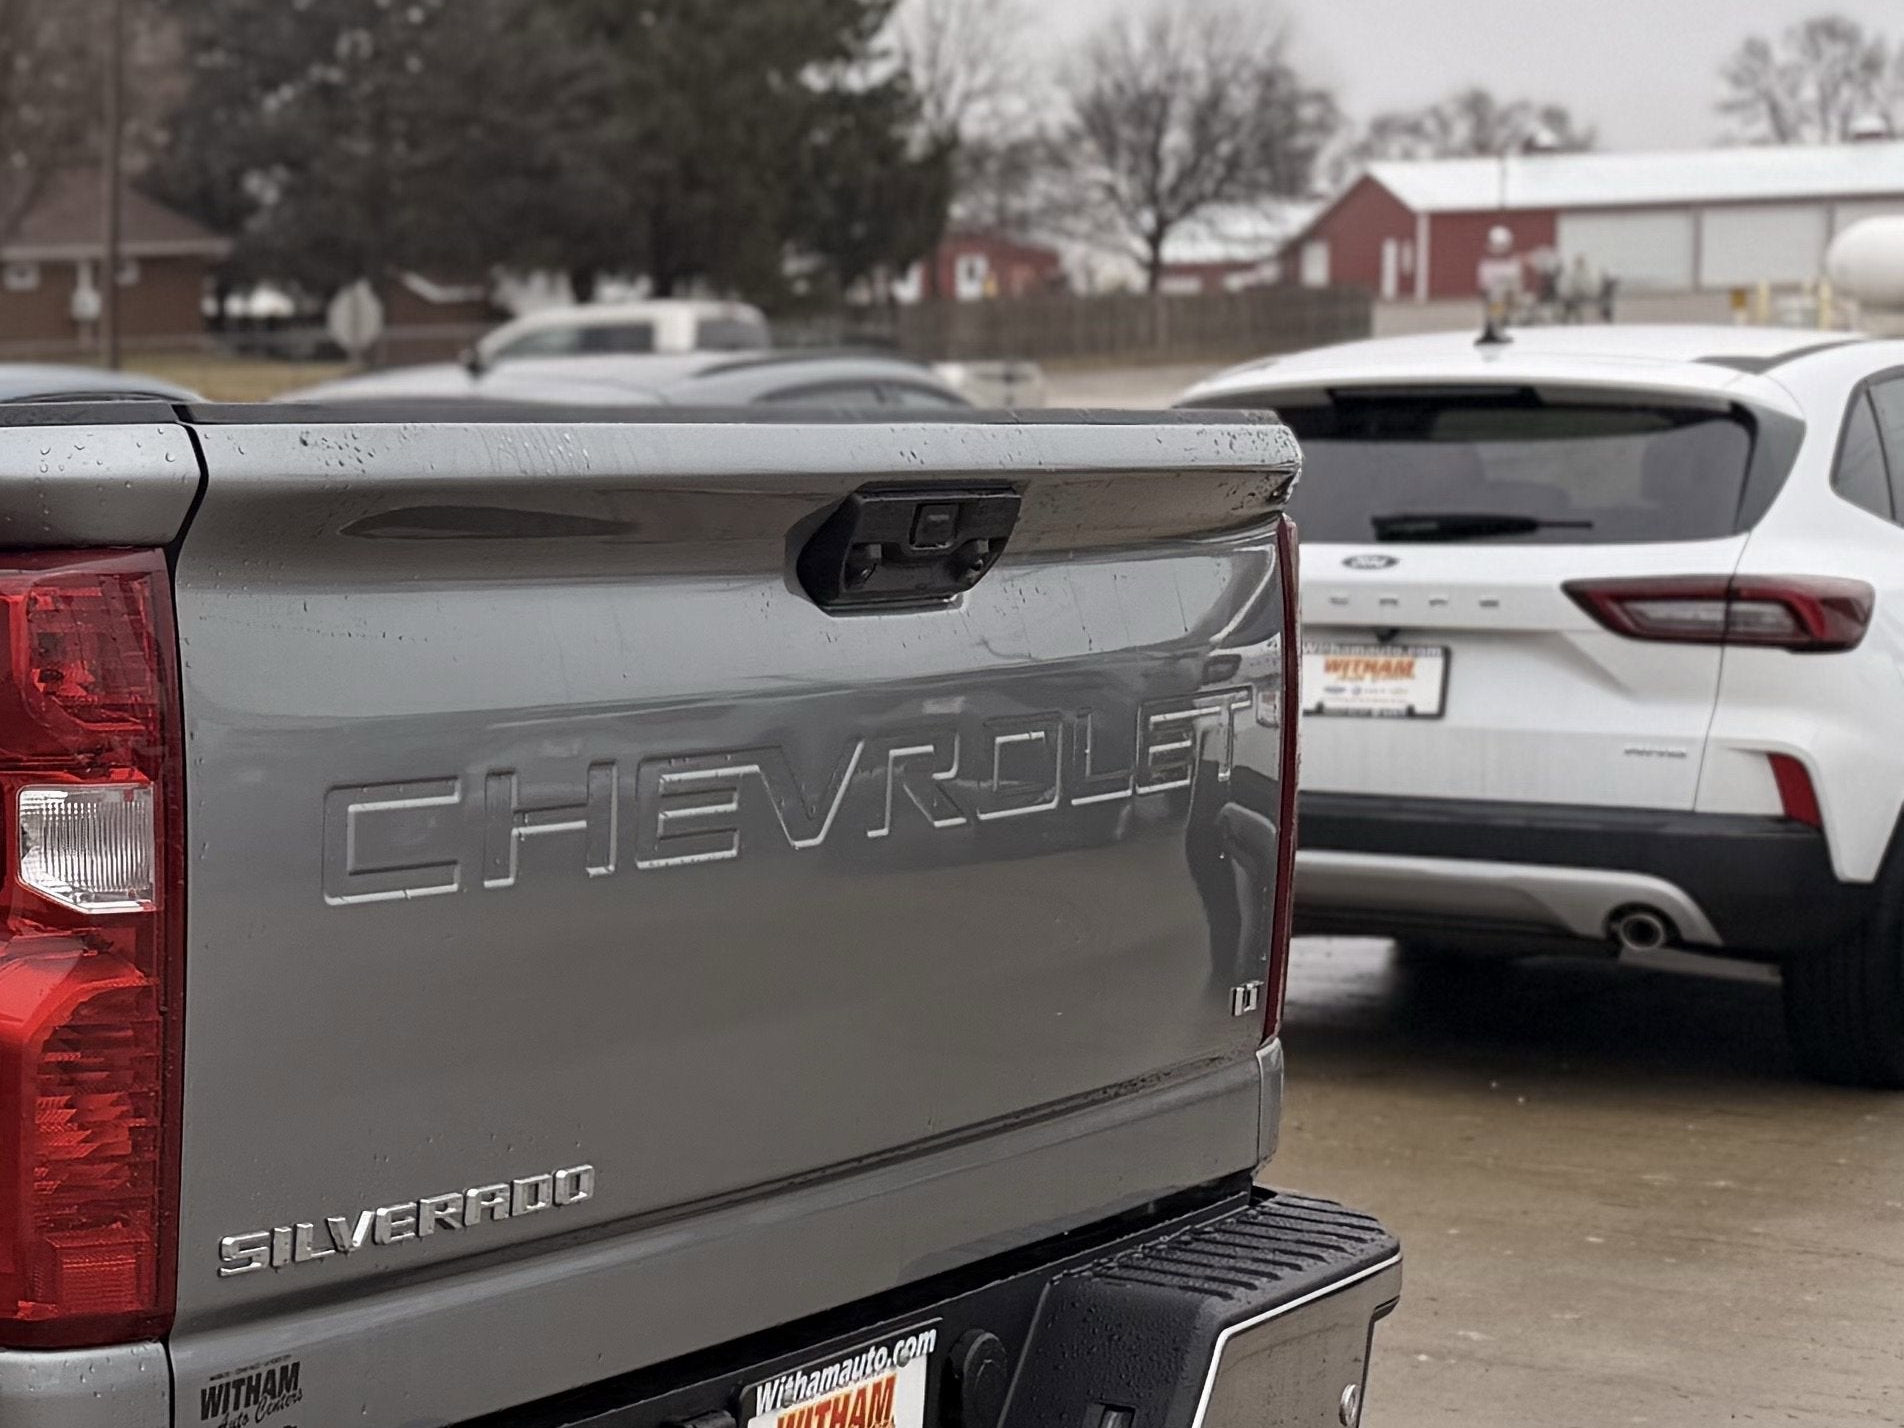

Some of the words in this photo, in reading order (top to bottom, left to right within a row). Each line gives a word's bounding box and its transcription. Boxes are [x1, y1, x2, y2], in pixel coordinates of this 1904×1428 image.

[322, 684, 1255, 906] CHEVROLET
[218, 1164, 594, 1277] SILVERADO
[201, 1361, 300, 1421] WITHAM
